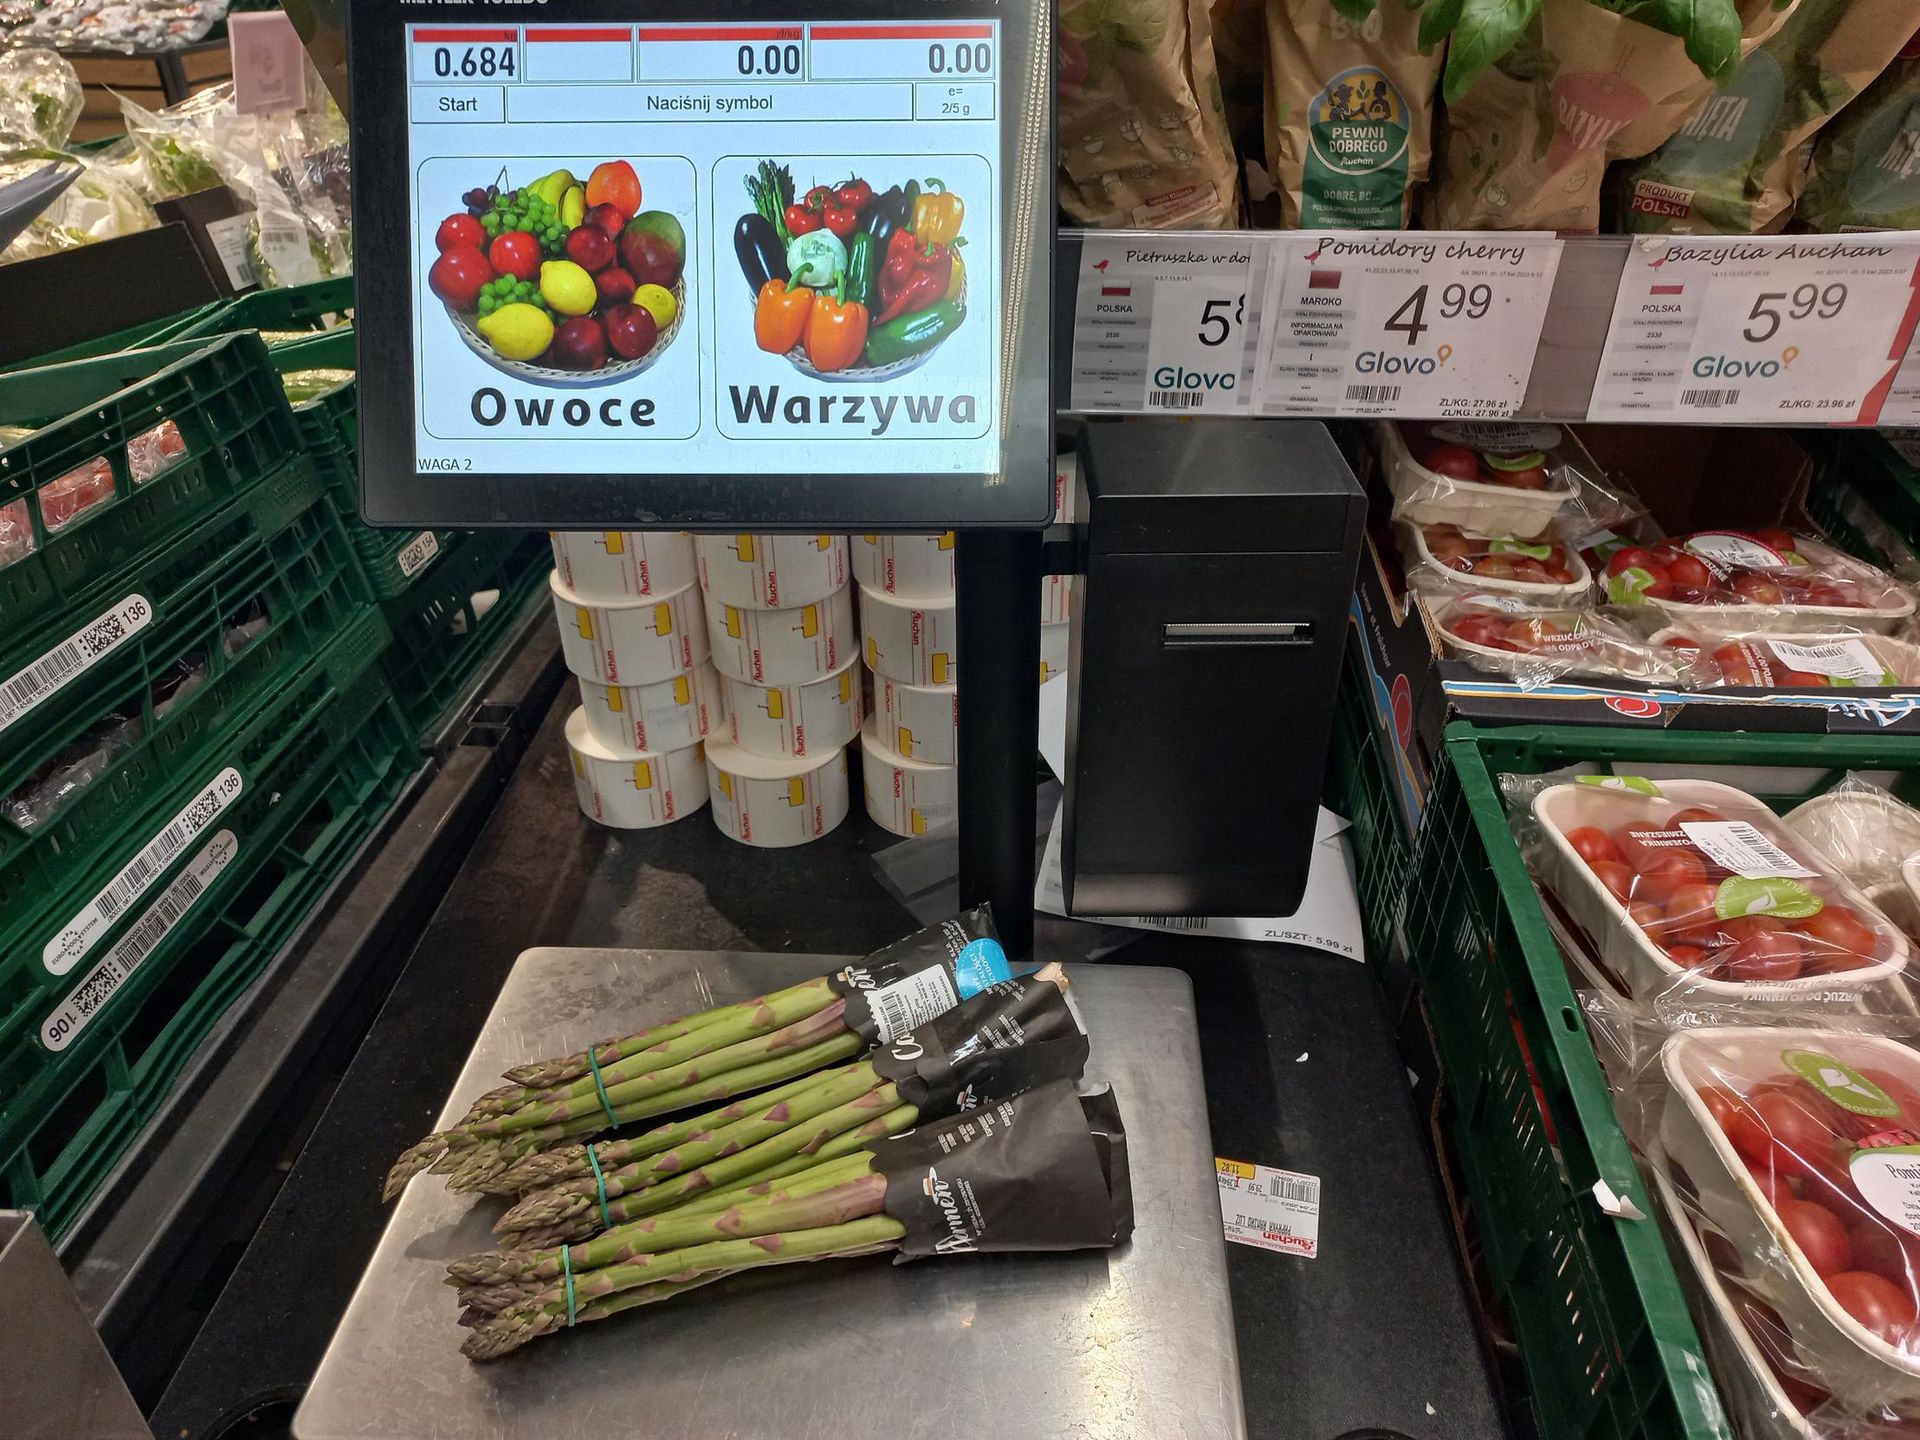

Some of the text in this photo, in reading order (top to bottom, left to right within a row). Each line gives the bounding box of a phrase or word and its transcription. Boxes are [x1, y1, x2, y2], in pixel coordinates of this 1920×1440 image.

[434, 47, 515, 77] 0.684
[738, 44, 800, 75] 0.00
[928, 43, 991, 74] 0.00
[438, 97, 477, 112] Start
[646, 94, 773, 113] Naciśnij symbol
[942, 103, 970, 115] 2/5 g
[1331, 127, 1385, 138] PEWNI
[1329, 140, 1388, 153] DOBREGO
[1340, 156, 1374, 166] Auchan
[1638, 183, 1690, 201] PRODUKT
[1632, 198, 1687, 217] POLSKI
[1126, 250, 1207, 264] Pietruszka
[1212, 254, 1228, 264] w
[1317, 237, 1525, 265] Pomidory cherry
[1665, 242, 1892, 265] Bazylia Auchan
[1097, 304, 1133, 313] POLSKA
[1300, 297, 1342, 306] MAROKO
[1641, 304, 1682, 313] POLSKA
[1290, 322, 1333, 330] INFORMACJA
[1355, 351, 1436, 375] Glovo
[1693, 355, 1779, 378] Glovo
[470, 387, 657, 428] Owoce
[728, 385, 977, 436] Warzywa
[1473, 399, 1496, 408] 27.96
[1475, 409, 1499, 418] 27.96
[1817, 399, 1843, 408] 23.96
[417, 457, 473, 472] WAGA 2
[639, 560, 651, 596] Auchan
[885, 558, 894, 593] Auchan
[768, 571, 778, 607] Auchan
[120, 600, 148, 626] 136
[912, 610, 922, 645] Auchan
[606, 650, 618, 683] Auchan
[753, 650, 762, 682] Auchan
[795, 725, 805, 757] Auchan
[216, 773, 241, 798] 136
[1264, 929, 1312, 942] ZL/SZT:
[1316, 937, 1340, 949] 5.99
[46, 1009, 79, 1044] 106
[1221, 1162, 1239, 1174] 11.82
[1248, 1182, 1262, 1192] 29.99
[1235, 1213, 1292, 1236] PAPRYKA RAMIRO LUZ
[1263, 1231, 1314, 1250] Auchan
